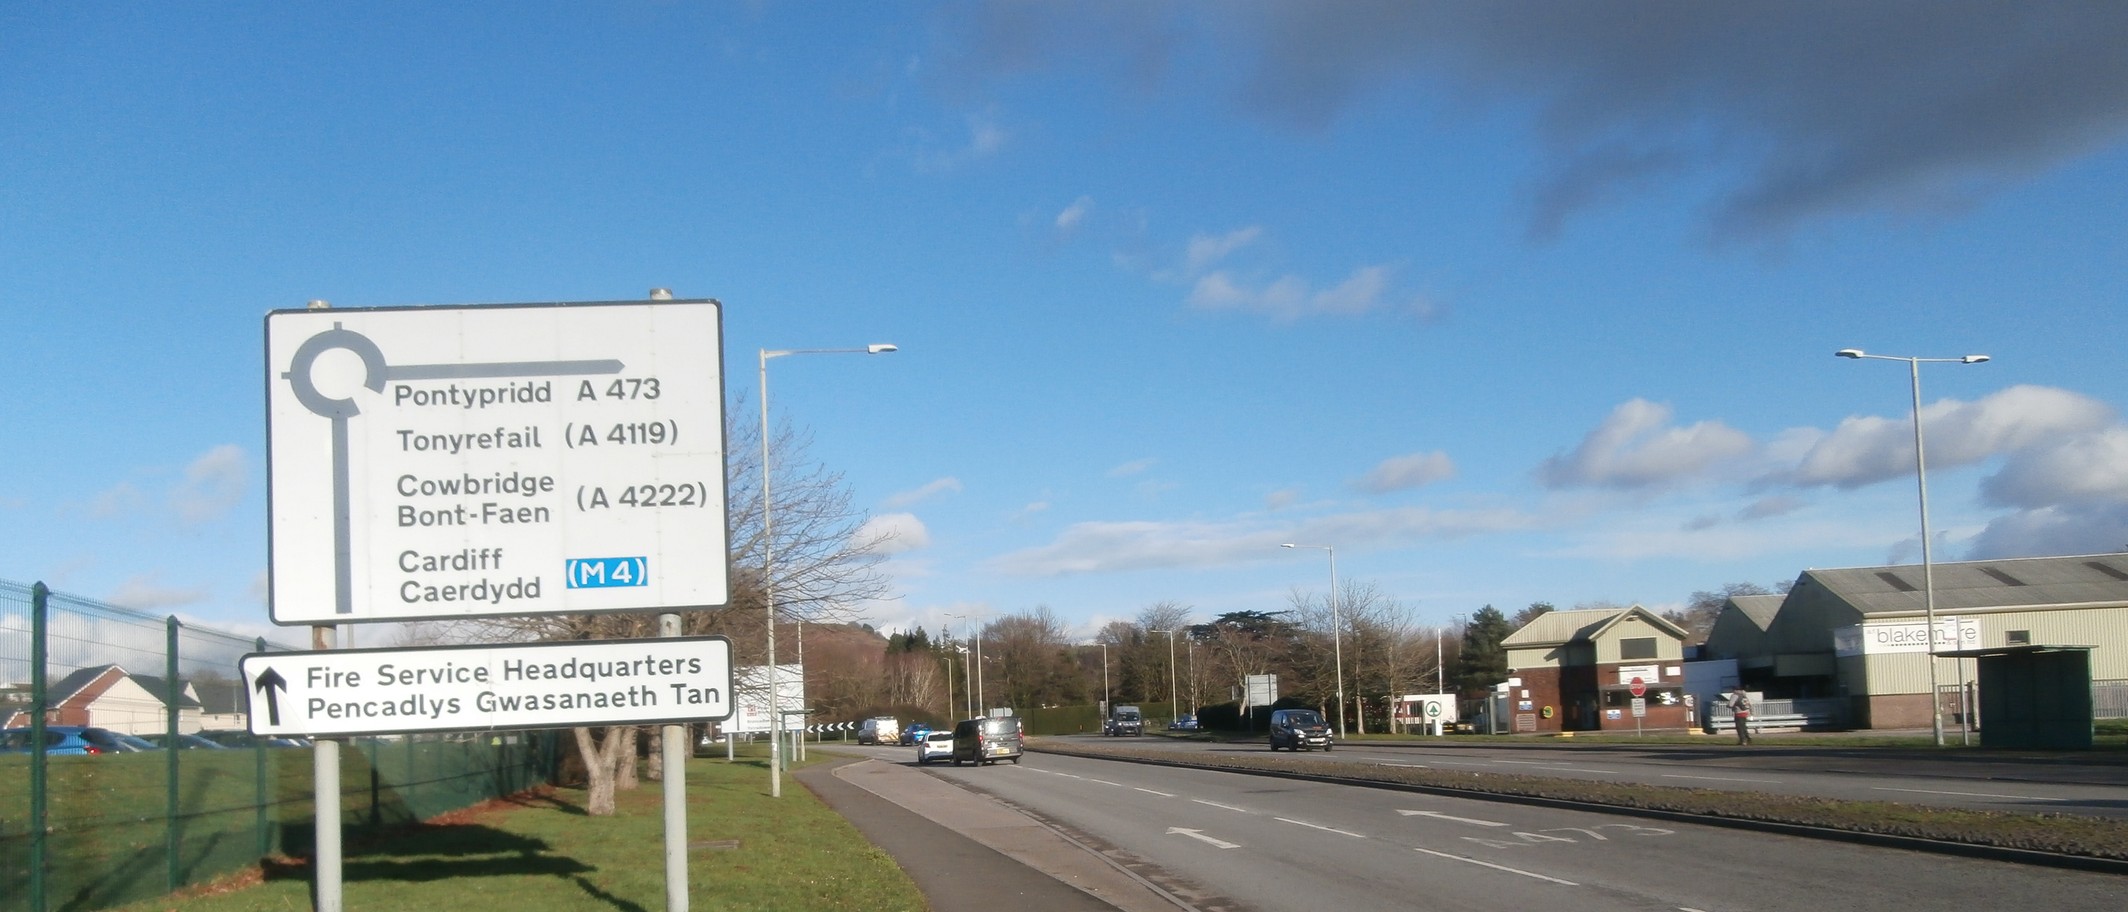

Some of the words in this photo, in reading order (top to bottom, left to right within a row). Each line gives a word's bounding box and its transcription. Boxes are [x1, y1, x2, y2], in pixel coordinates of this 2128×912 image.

[395, 381, 551, 409] Pontypridd
[577, 380, 597, 401] A
[606, 378, 660, 400] 473
[397, 426, 541, 454] Tonyrefail
[566, 423, 598, 448] (A
[607, 419, 677, 445] 4119)
[398, 472, 554, 497] Cowbridge
[577, 486, 609, 511] (A
[619, 482, 706, 507] 4222)
[399, 503, 549, 526] Bont-Faen
[399, 548, 502, 572] Cardiff
[401, 577, 540, 604] Caerdydd
[1877, 627, 1976, 643] blakemre
[308, 667, 360, 688] Fire
[378, 665, 488, 685] Service
[504, 655, 701, 682] Headquarters
[309, 694, 460, 719] Pencadlys
[477, 685, 656, 712] Gwasanaeth
[670, 683, 719, 704] Tan
